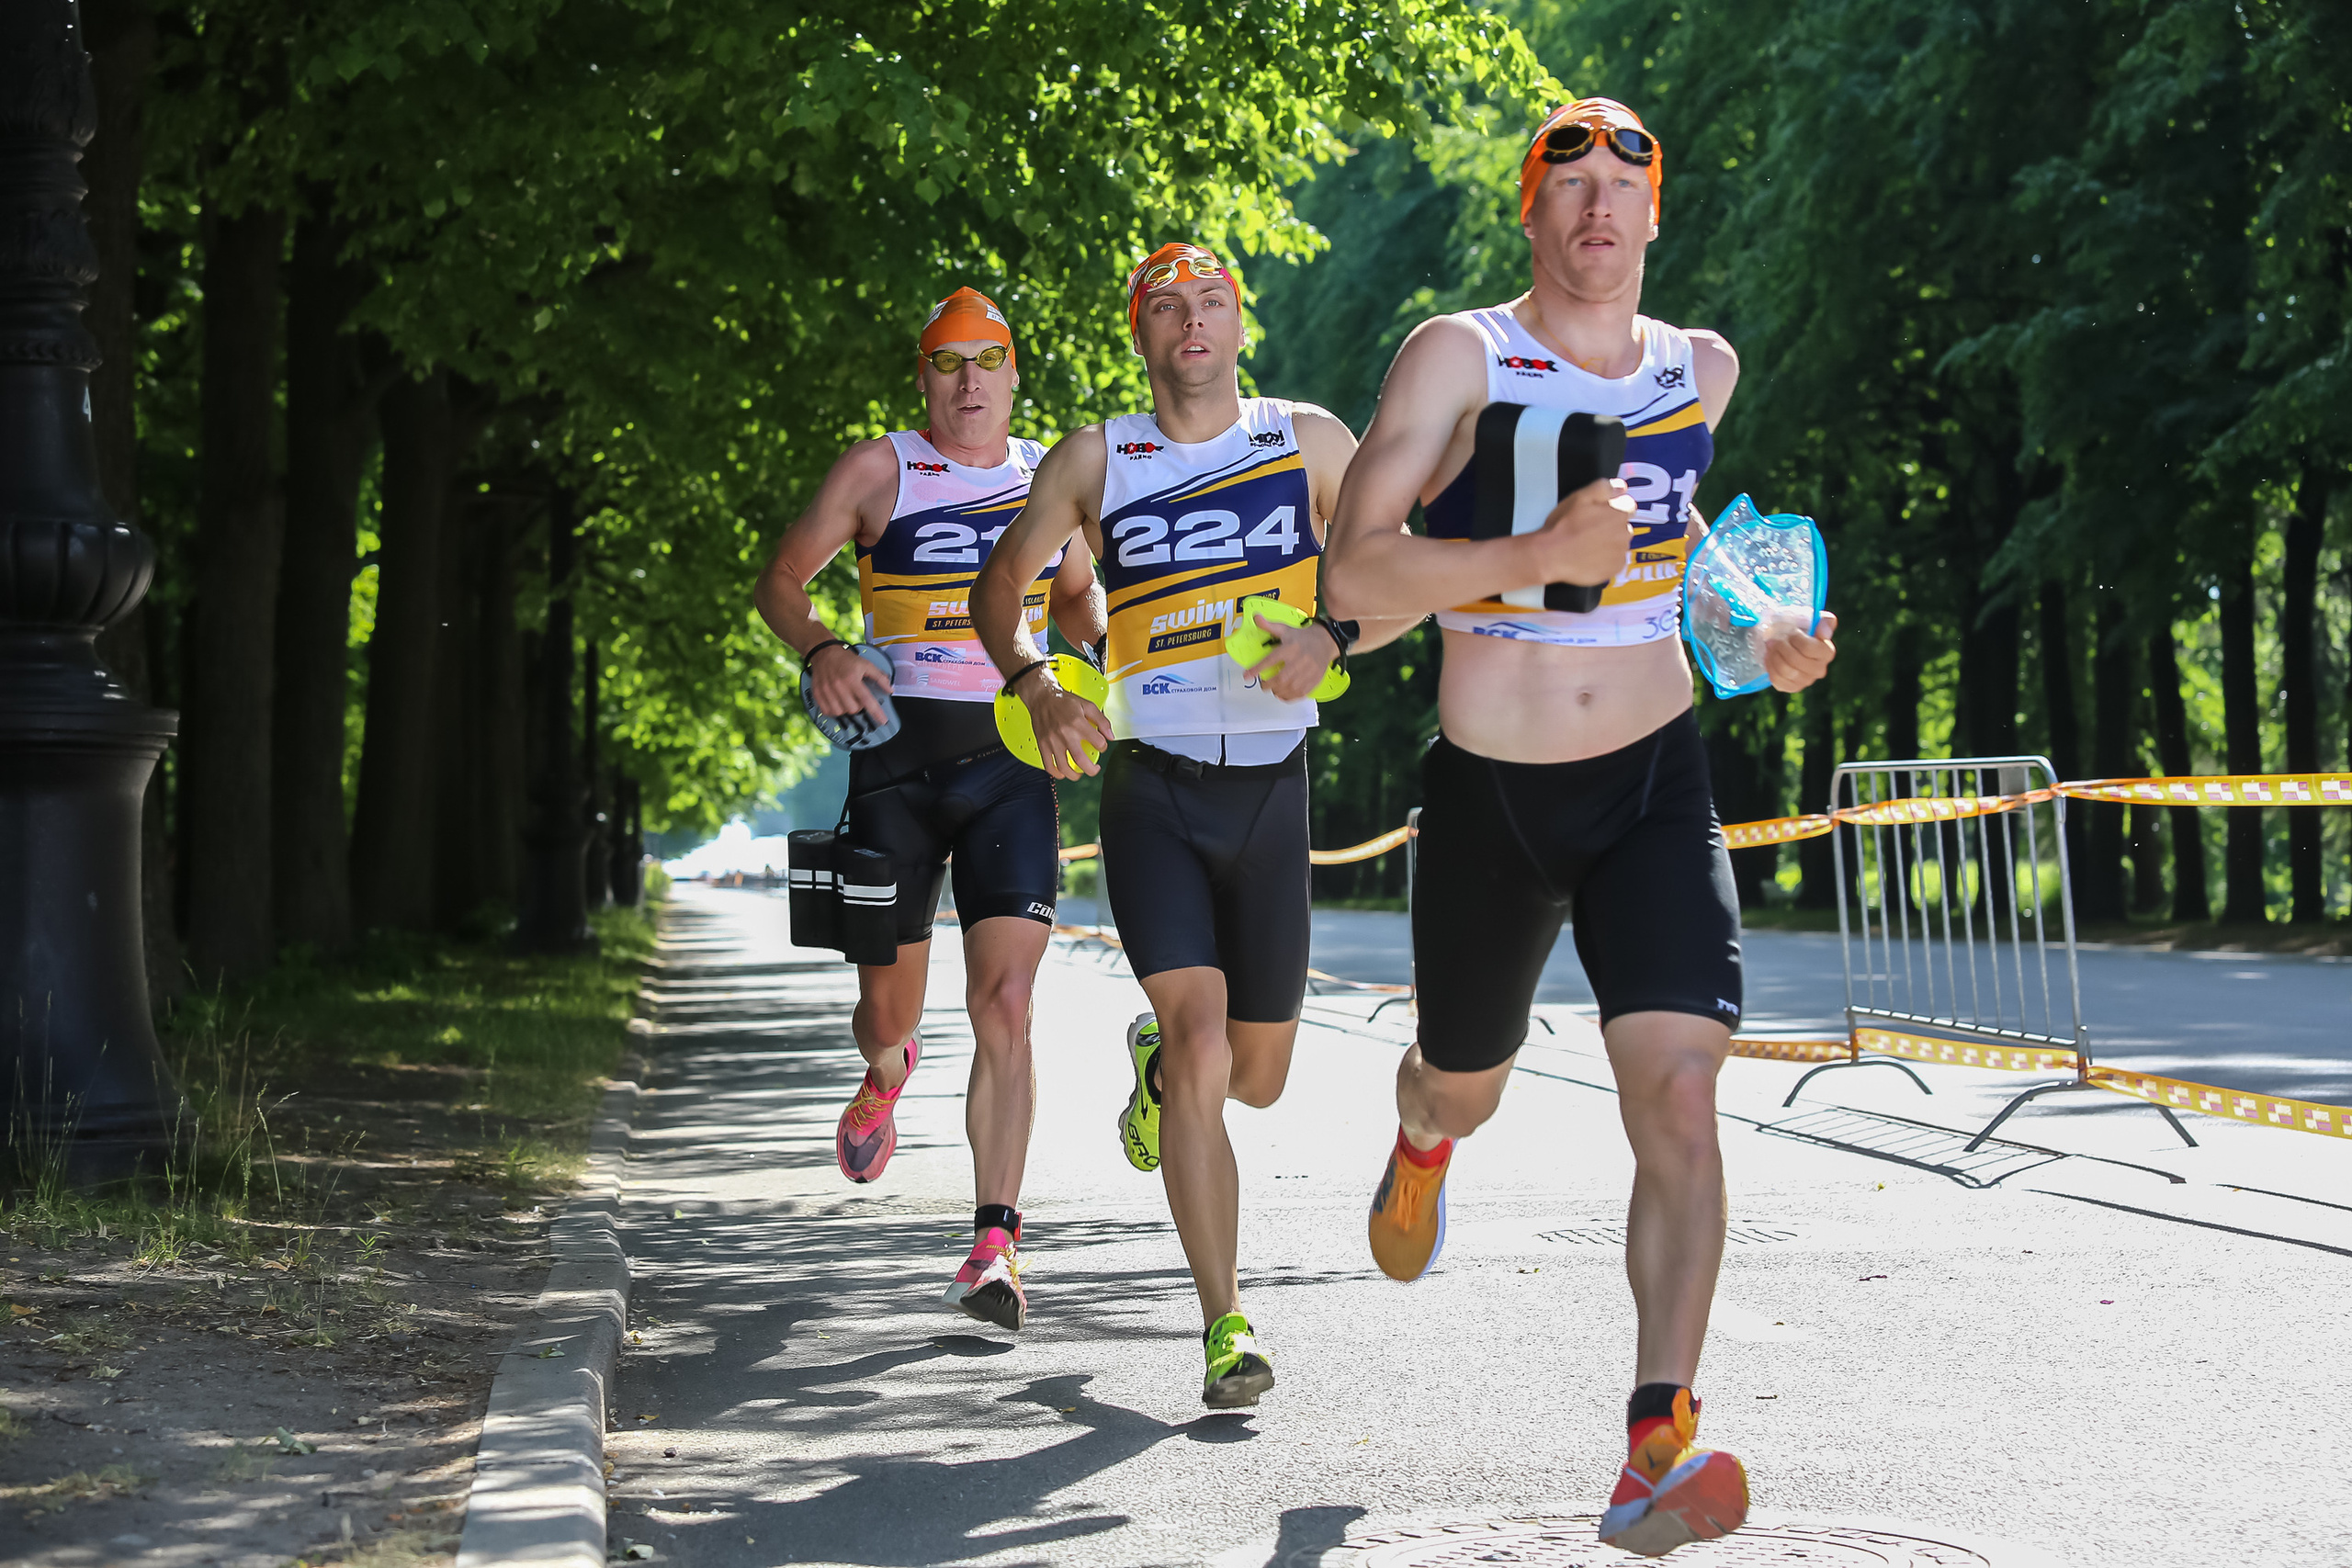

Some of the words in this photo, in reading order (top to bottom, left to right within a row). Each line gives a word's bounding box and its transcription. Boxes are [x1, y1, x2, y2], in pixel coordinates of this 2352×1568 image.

[1616, 462, 1697, 525] 21
[1112, 505, 1300, 567] 224
[944, 618, 971, 627] PETERS
[1155, 638, 1166, 649] ST.
[1167, 628, 1213, 646] PETERSBURG
[914, 651, 944, 663] ВСК
[1142, 682, 1171, 695] ВСК
[1170, 686, 1203, 694] СТРАХОВОЙ
[1127, 1122, 1161, 1168] BRO
